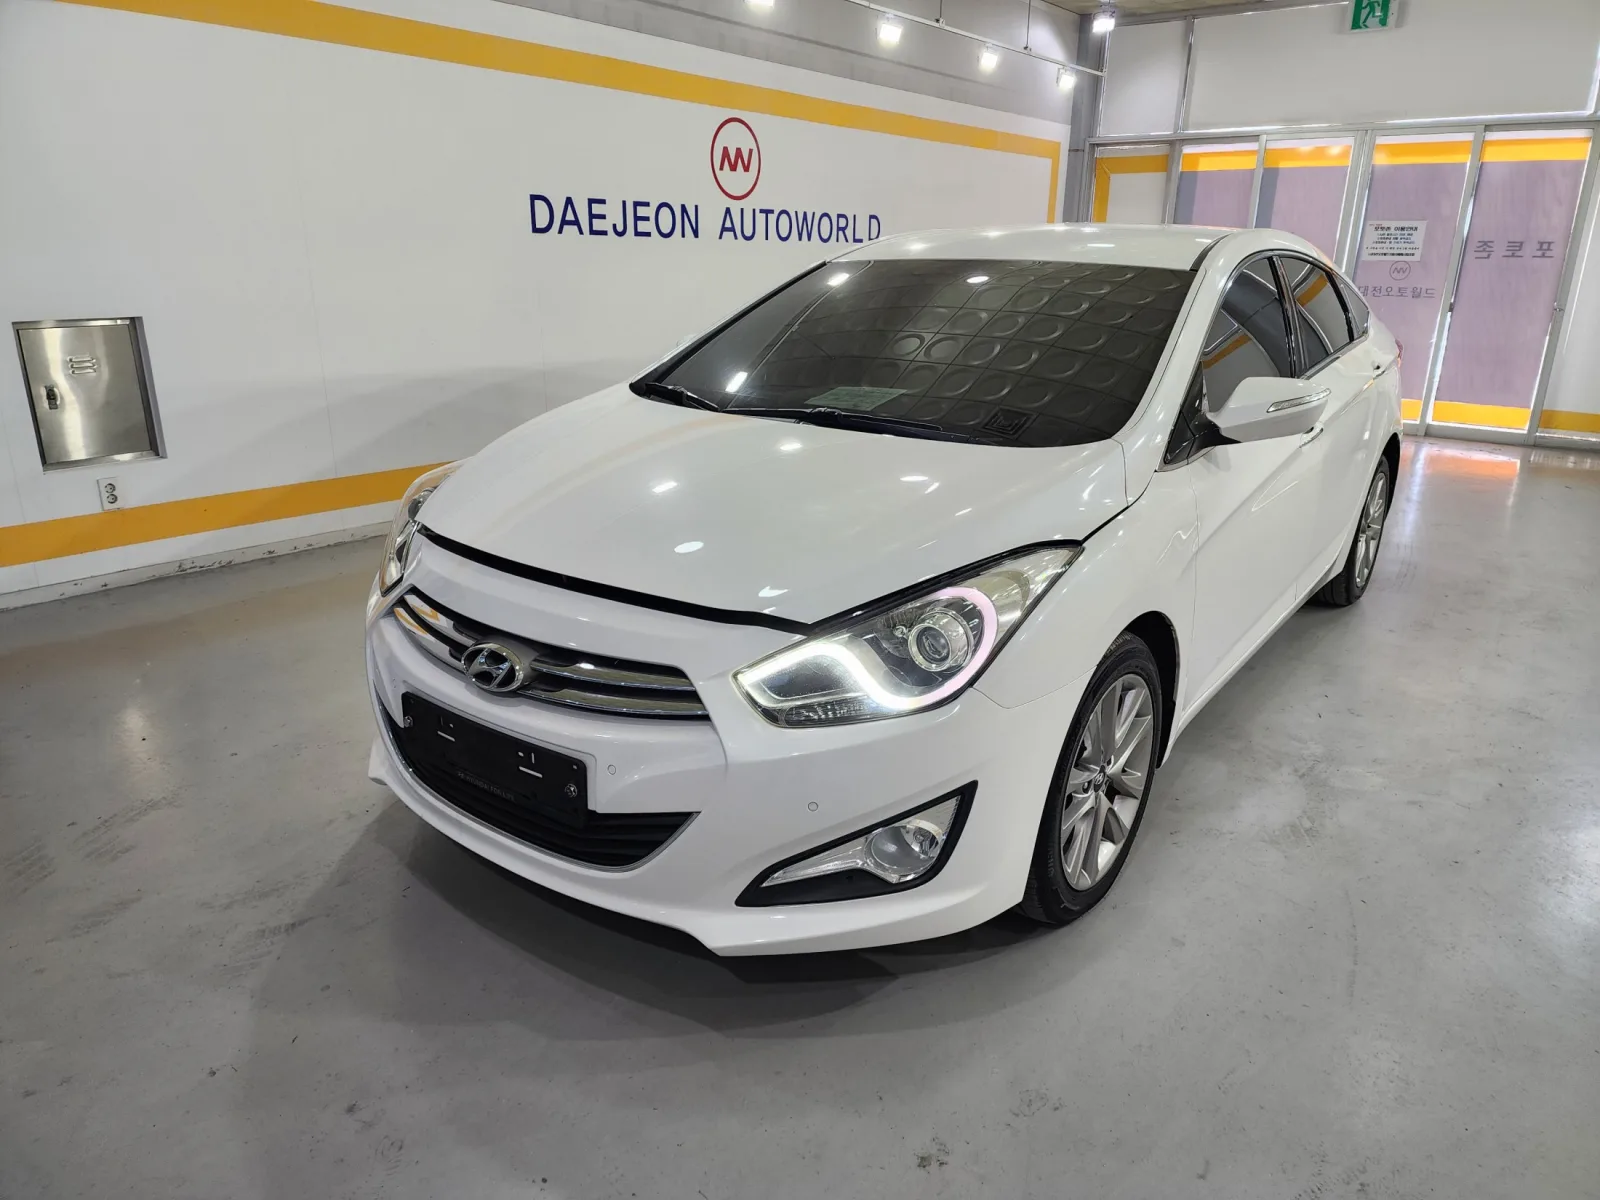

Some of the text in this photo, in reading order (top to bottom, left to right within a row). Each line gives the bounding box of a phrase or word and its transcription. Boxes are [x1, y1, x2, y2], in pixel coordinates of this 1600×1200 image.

[529, 193, 882, 244] DAEJEON AUTOWORLD
[1358, 285, 1436, 299] 대전오토월드
